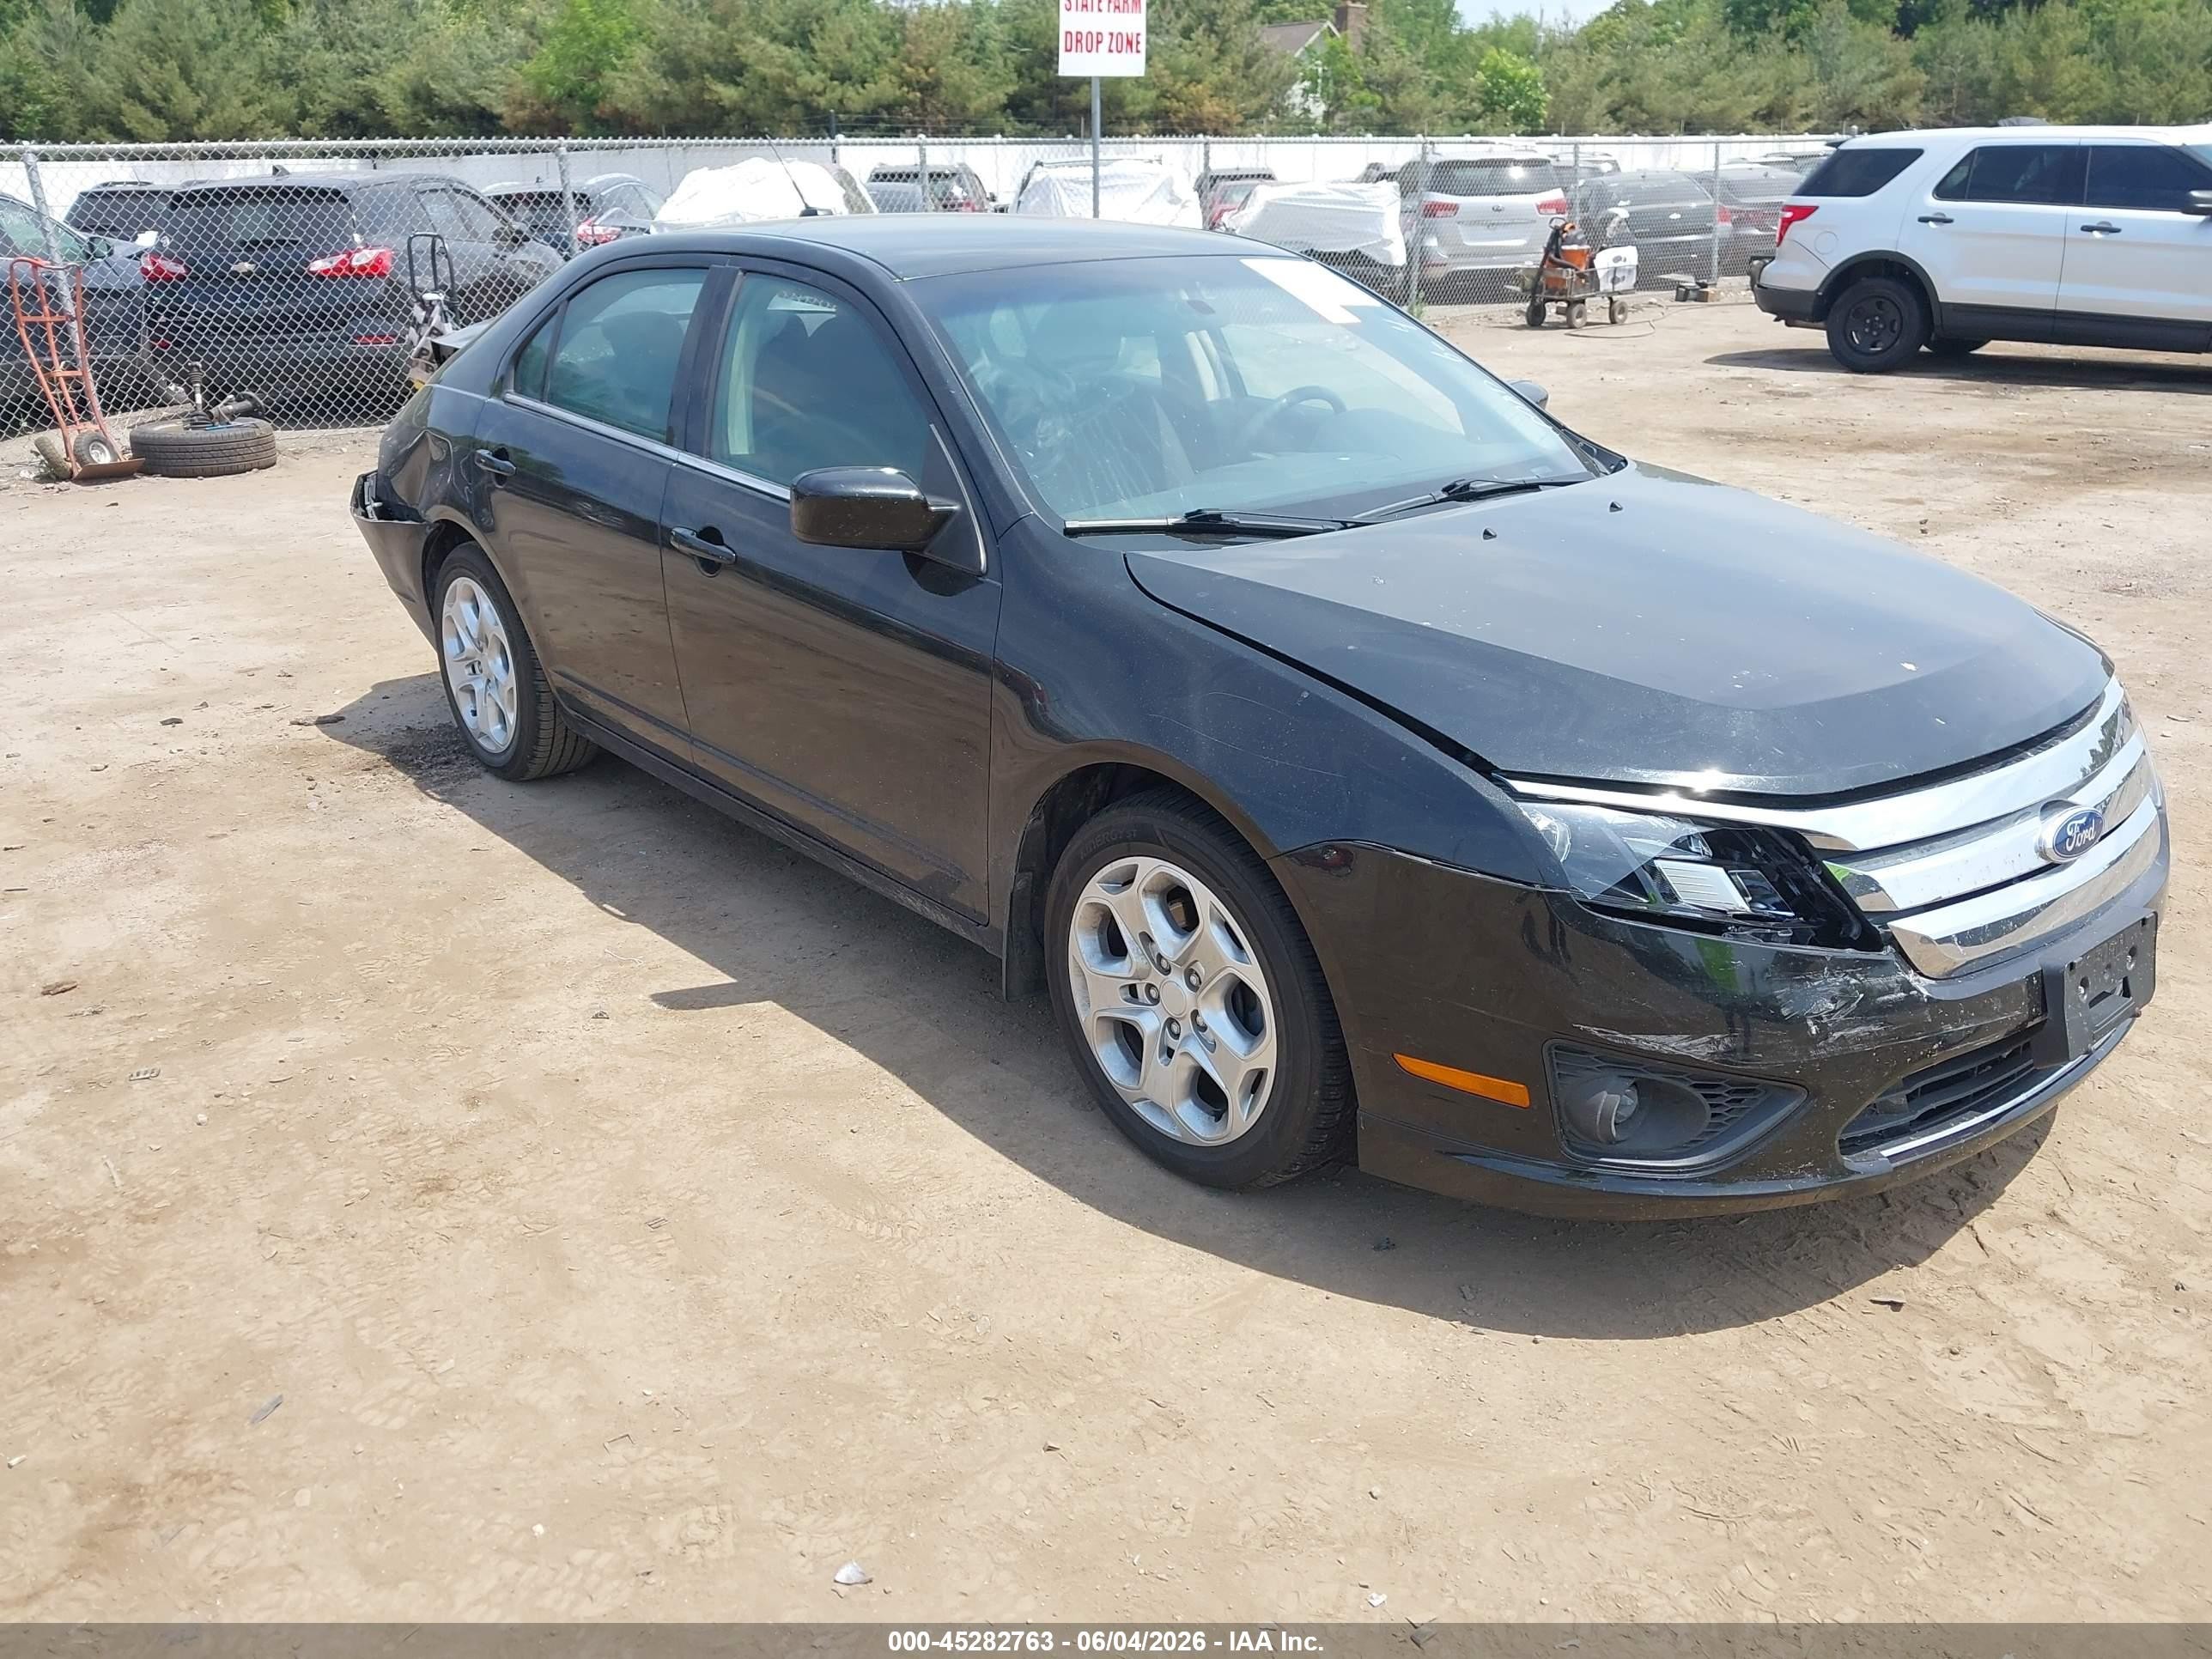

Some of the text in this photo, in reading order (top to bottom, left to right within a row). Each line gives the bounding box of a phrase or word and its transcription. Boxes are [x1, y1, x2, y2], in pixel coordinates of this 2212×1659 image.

[1065, 0, 1142, 14] STATE FARM
[1064, 31, 1141, 53] DROP ZONE
[2065, 816, 2096, 852] Ford
